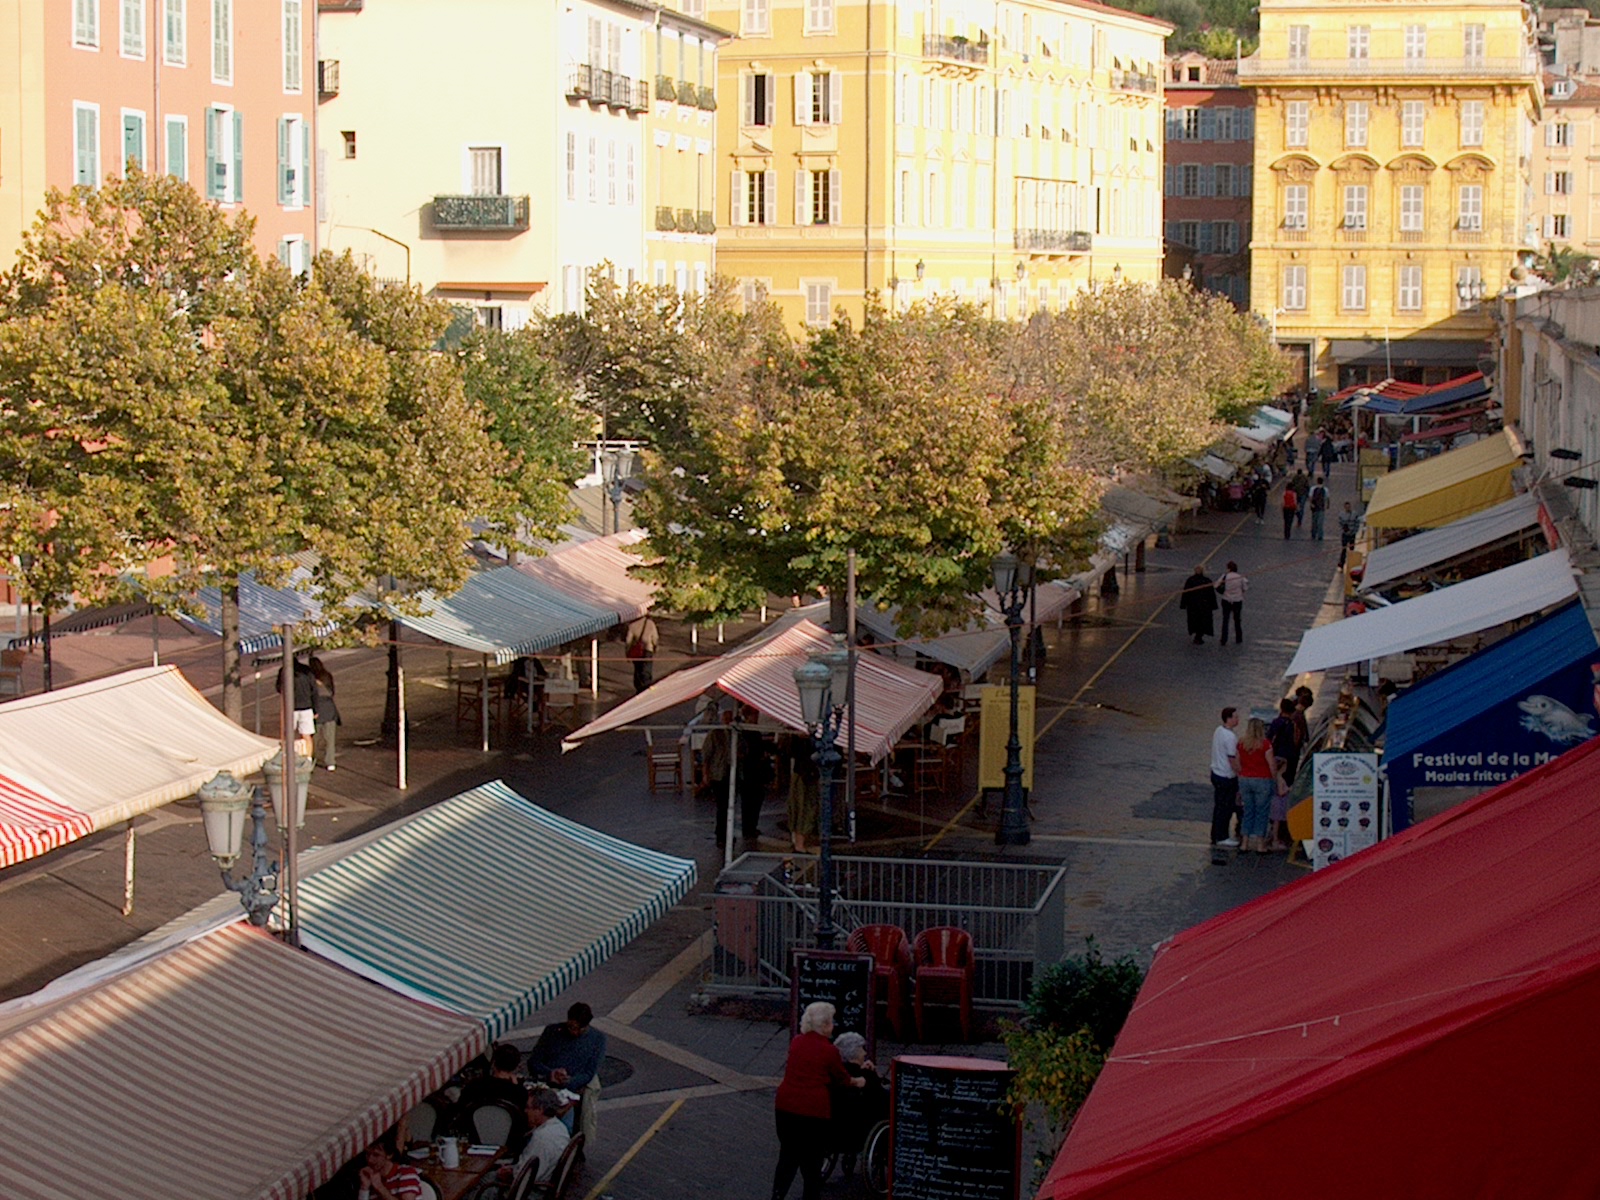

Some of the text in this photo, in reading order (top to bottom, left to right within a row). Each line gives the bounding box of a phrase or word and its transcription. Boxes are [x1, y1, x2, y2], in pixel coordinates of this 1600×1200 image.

[1413, 751, 1483, 768] Festival
[1487, 751, 1510, 766] de
[1513, 751, 1531, 766] la
[1425, 770, 1471, 783] Moules
[1473, 770, 1507, 782] frites
